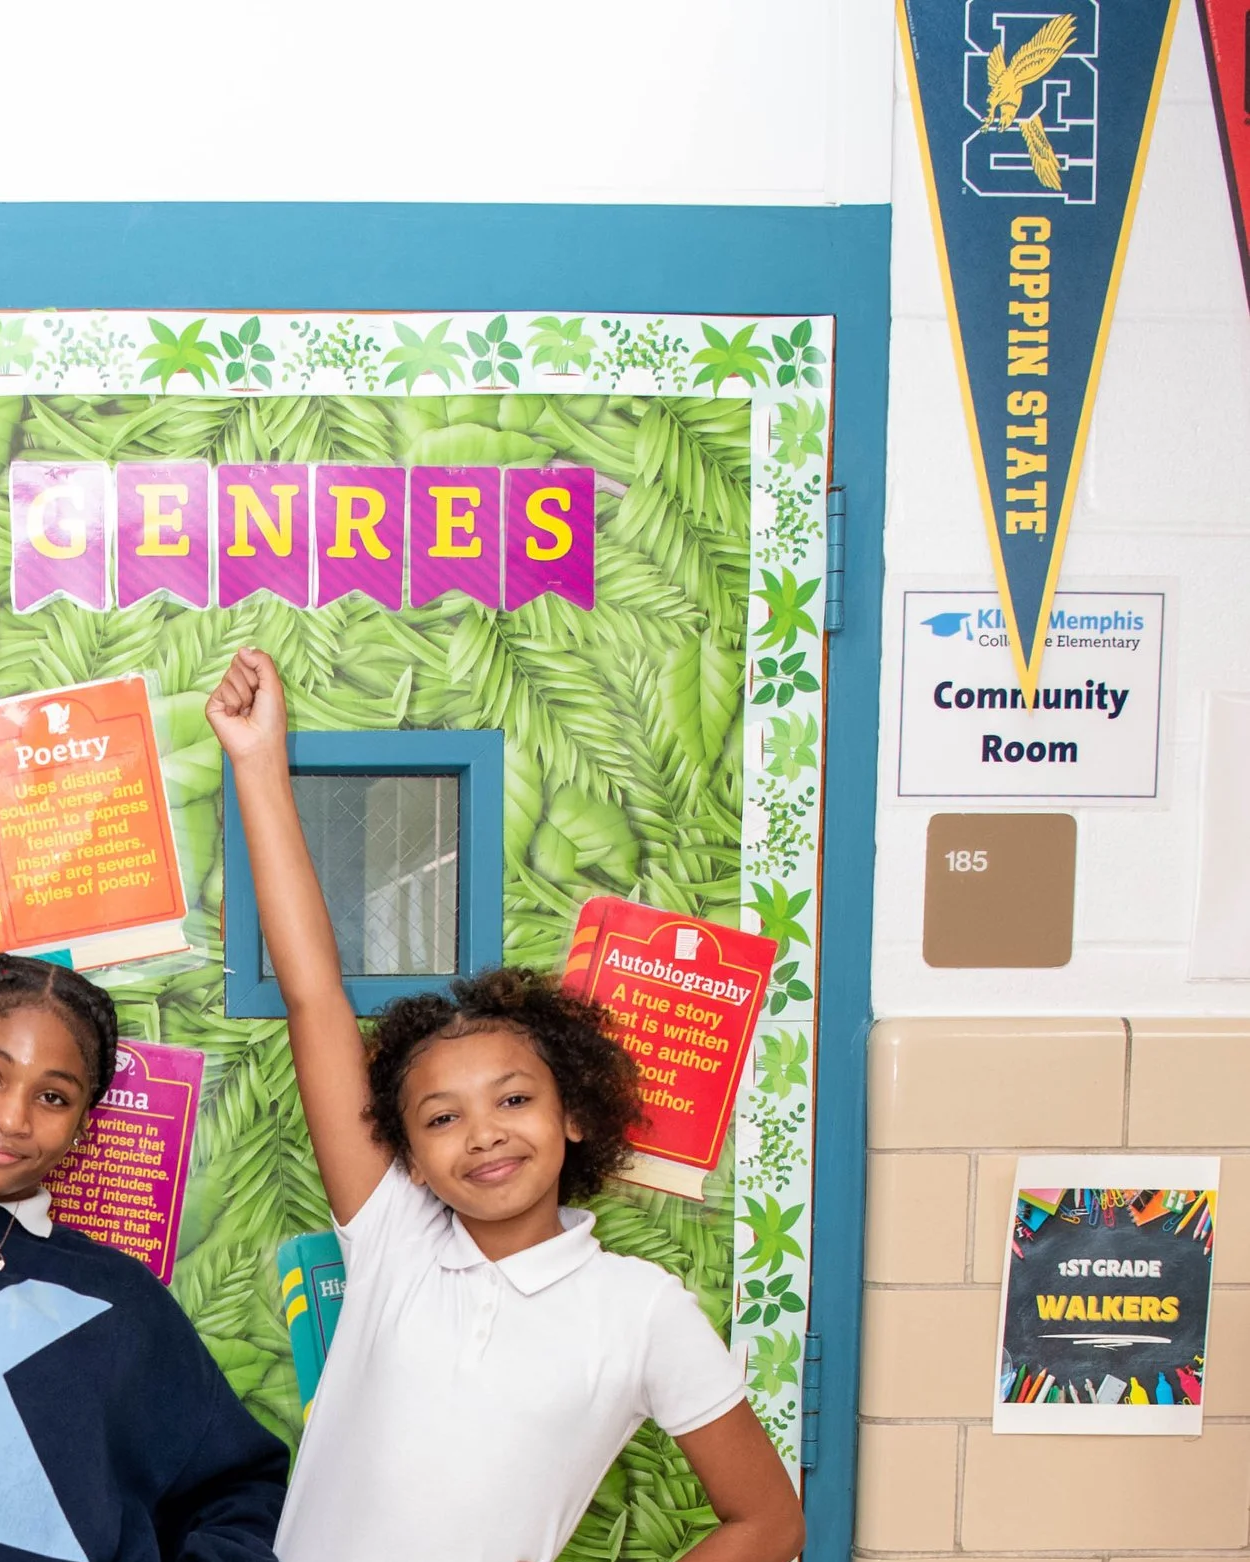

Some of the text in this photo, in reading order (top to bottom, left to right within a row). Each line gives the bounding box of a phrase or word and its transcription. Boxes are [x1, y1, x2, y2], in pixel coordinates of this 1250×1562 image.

[1006, 215, 1051, 535] COPPIN STATE
[27, 482, 575, 561] GENRES
[1057, 635, 1141, 651] Elementary
[933, 680, 1130, 719] Community
[15, 735, 110, 769] Poetry
[982, 735, 1078, 763] Room
[15, 766, 122, 799] Uses distinct
[0, 779, 144, 820] sound, verse, and
[0, 800, 149, 838] rhythm to express
[27, 819, 129, 851] feelings and
[11, 849, 157, 889] There are several
[17, 837, 145, 871] inspire readers.
[945, 850, 988, 872] 185
[25, 871, 155, 906] styles of poetry.
[604, 948, 751, 1007] Autobiography
[611, 983, 723, 1031] A true story
[641, 1014, 659, 1034] is
[663, 1023, 729, 1053] written
[622, 1033, 723, 1074] the author
[635, 1058, 677, 1086] bout
[97, 1118, 142, 1134] written
[146, 1123, 159, 1137] in
[97, 1133, 135, 1147] prose
[139, 1137, 166, 1153] that
[104, 1147, 162, 1166] depicted
[69, 1170, 95, 1183] plot
[98, 1173, 153, 1193] includes
[81, 1158, 170, 1181] performance.
[84, 1200, 98, 1212] of
[100, 1203, 165, 1224] character,
[86, 1187, 100, 1198] of
[102, 1188, 157, 1209] interest,
[59, 1212, 120, 1230] emotions
[124, 1219, 150, 1235] that
[111, 1232, 162, 1252] through
[1058, 1259, 1163, 1278] 1ST GRADE
[1036, 1295, 1180, 1322] WALKERS
